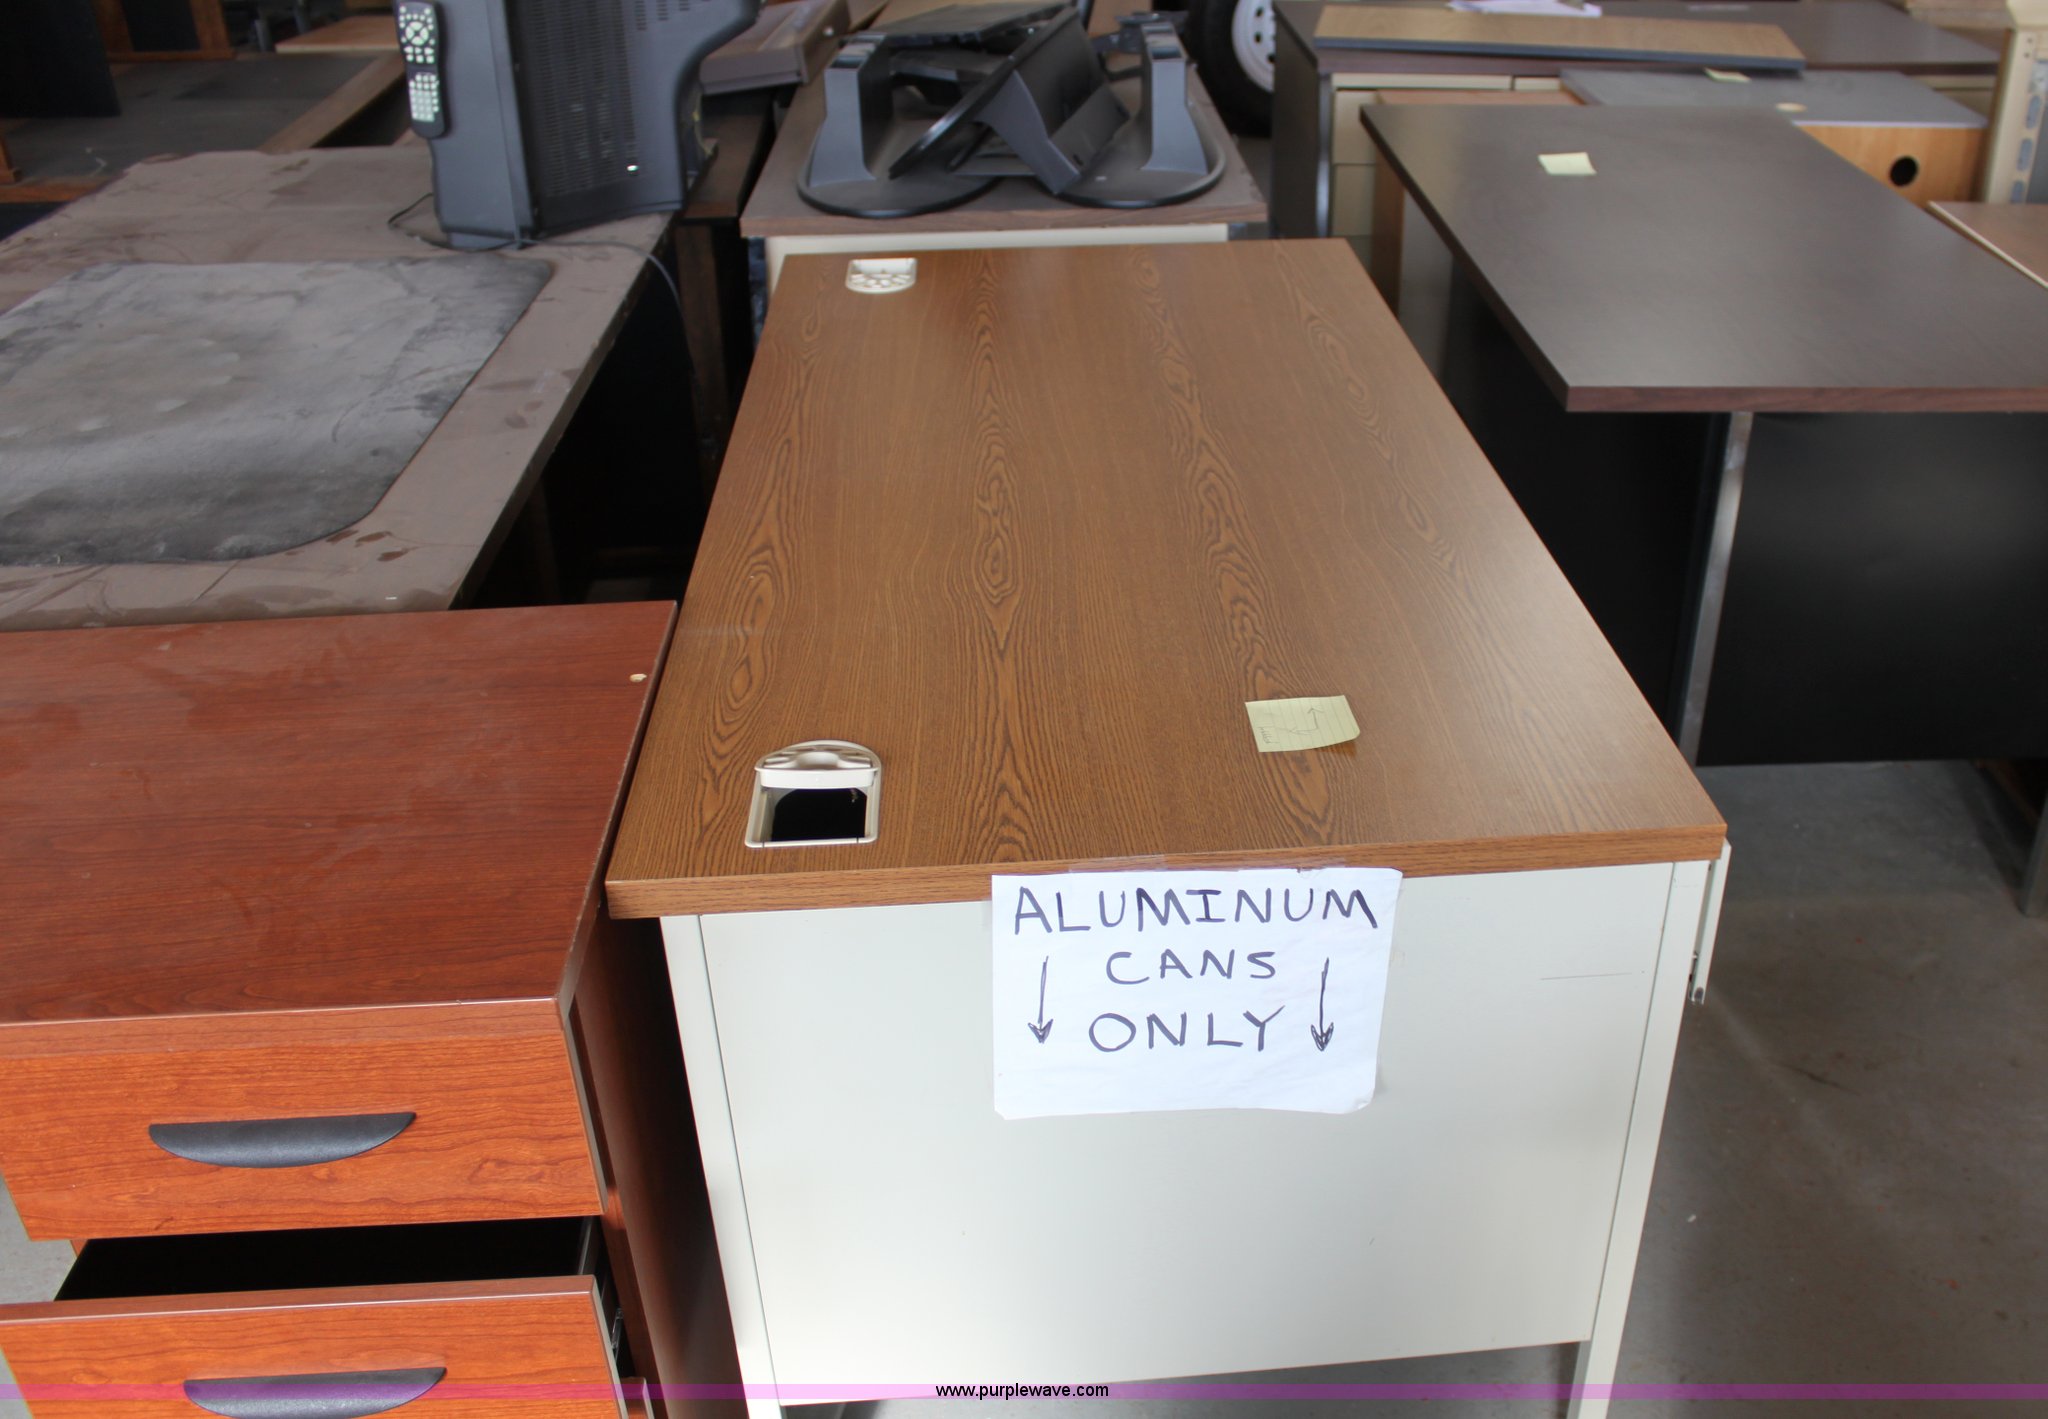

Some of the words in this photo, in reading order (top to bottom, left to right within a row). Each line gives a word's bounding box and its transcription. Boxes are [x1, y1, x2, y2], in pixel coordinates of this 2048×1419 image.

[1014, 886, 1378, 934] ALUMINUM
[1106, 949, 1276, 985] CANS
[1089, 1005, 1285, 1052] ONLY
